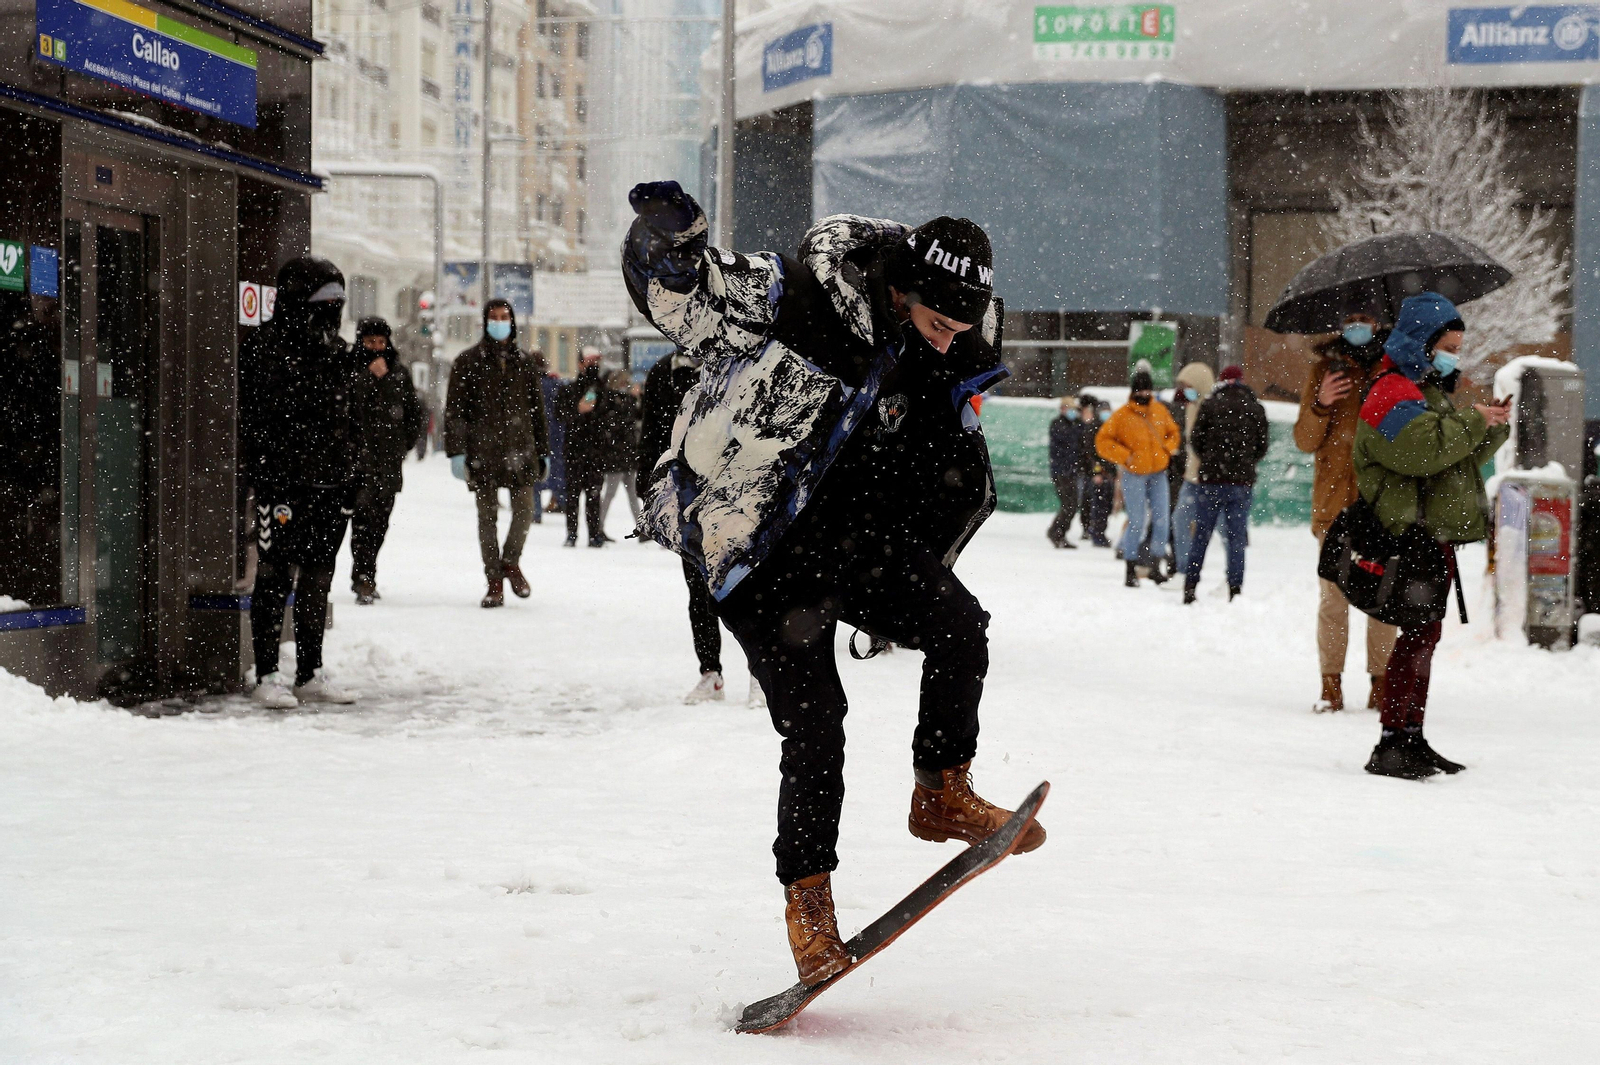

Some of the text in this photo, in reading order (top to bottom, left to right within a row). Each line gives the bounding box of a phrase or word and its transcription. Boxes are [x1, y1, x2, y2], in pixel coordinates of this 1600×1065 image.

[1459, 22, 1550, 47] Allianz
[132, 32, 180, 71] Callao
[133, 75, 150, 91] Plaza
[151, 82, 160, 94] del
[162, 85, 181, 101] Callao
[924, 238, 971, 277] huf
